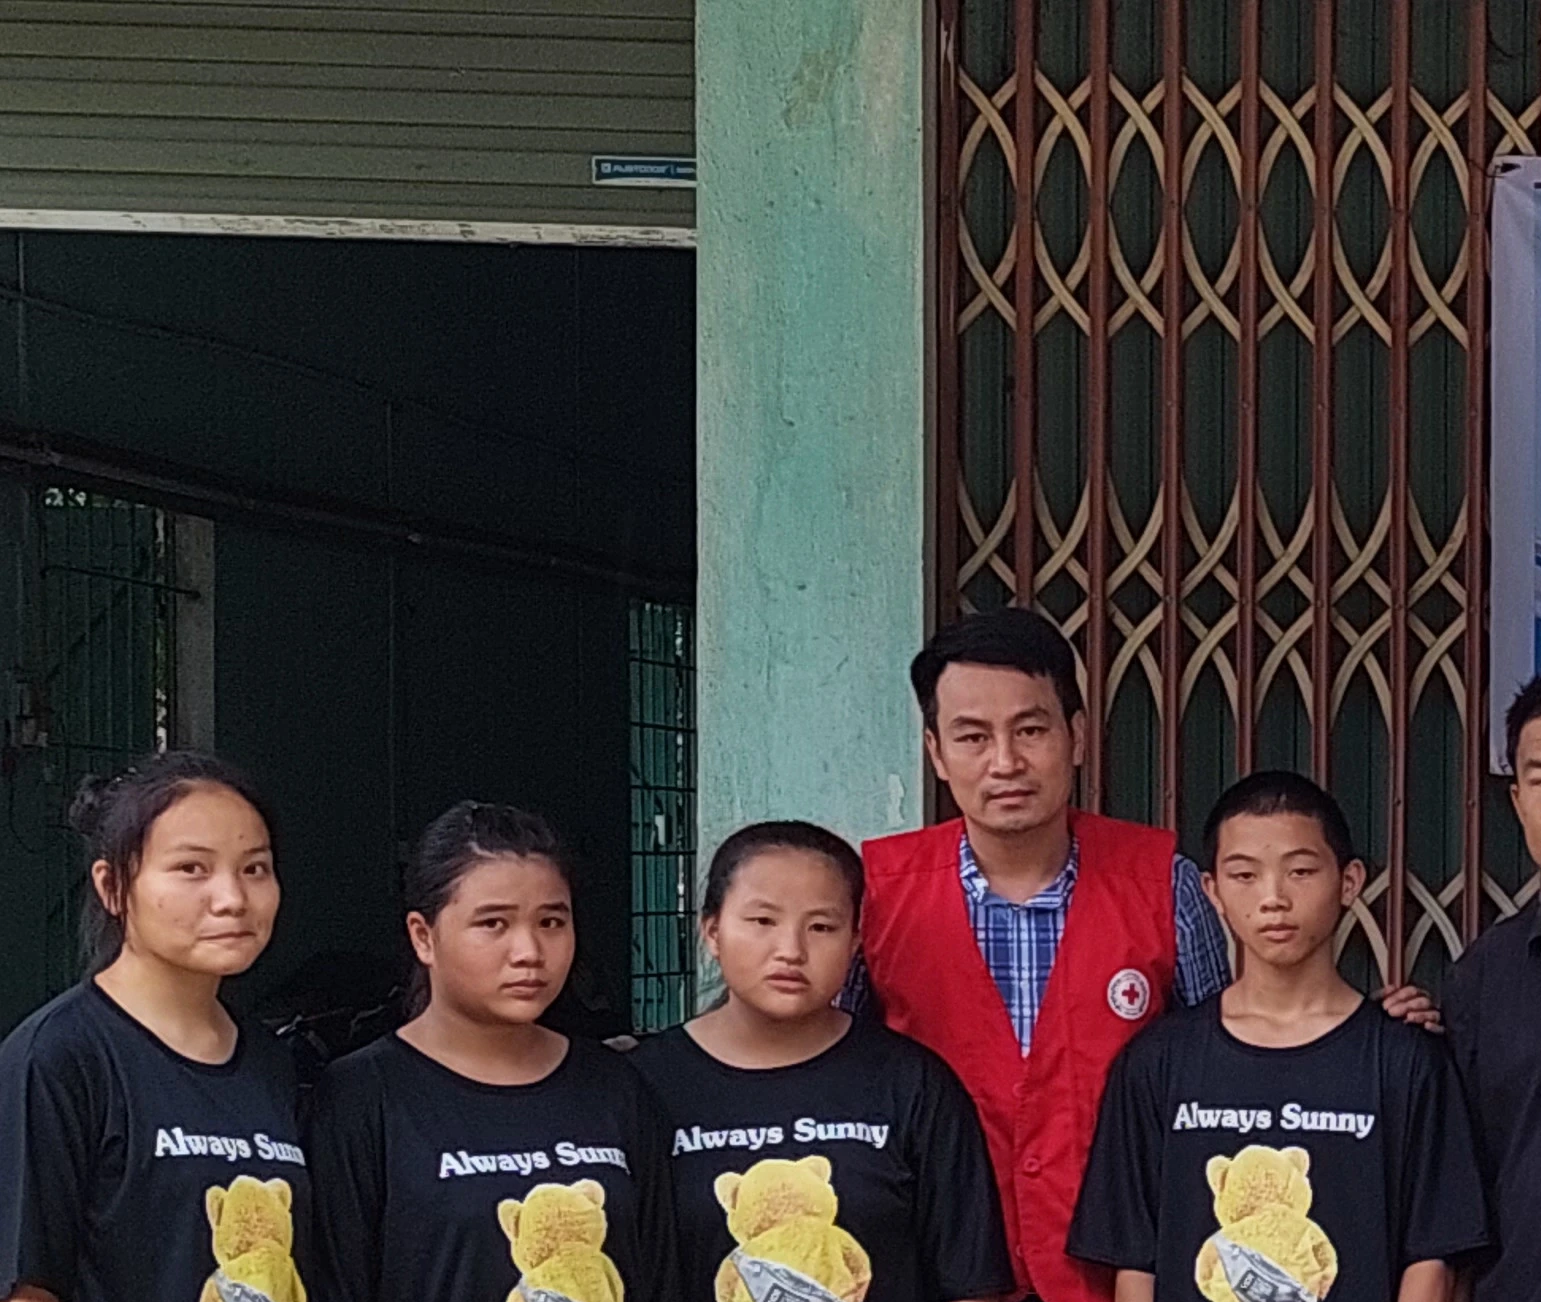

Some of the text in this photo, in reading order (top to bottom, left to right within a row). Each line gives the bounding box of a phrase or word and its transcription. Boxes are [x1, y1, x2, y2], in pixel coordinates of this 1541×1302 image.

[671, 1117, 890, 1158] Always Sunny
[1173, 1103, 1375, 1139] Always Sunny
[155, 1127, 251, 1162] Always
[439, 1150, 551, 1179] Always
